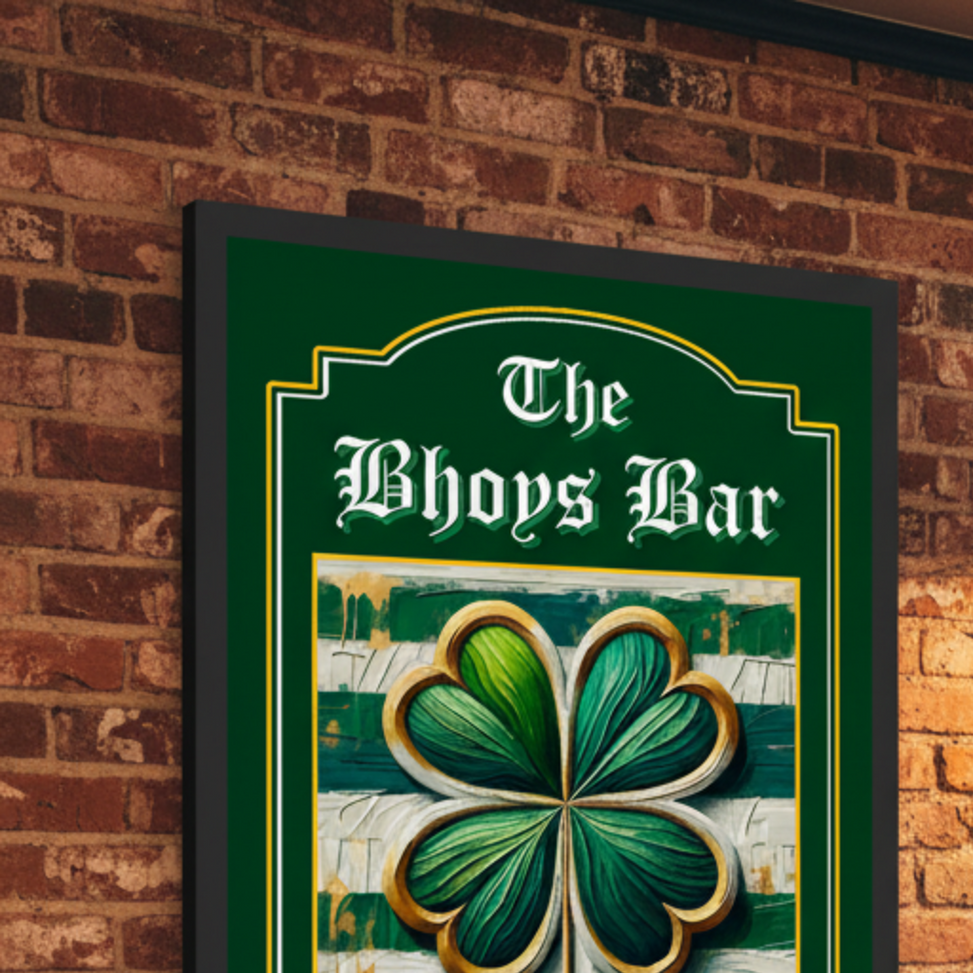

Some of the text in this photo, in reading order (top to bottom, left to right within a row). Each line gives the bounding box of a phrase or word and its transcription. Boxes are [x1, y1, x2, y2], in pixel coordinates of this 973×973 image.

[497, 355, 632, 440] The
[333, 434, 784, 546] Bhoys Bar
